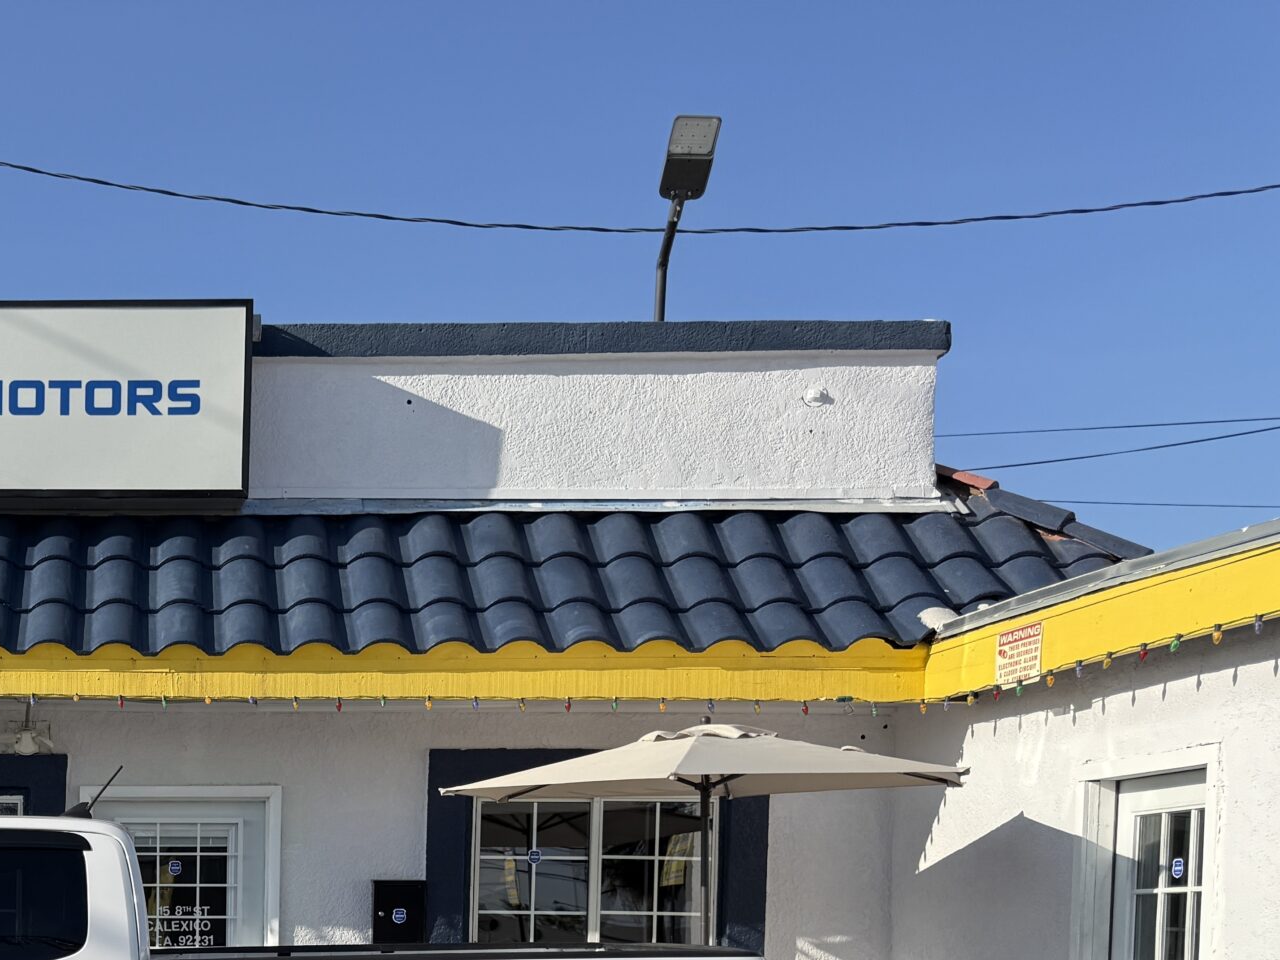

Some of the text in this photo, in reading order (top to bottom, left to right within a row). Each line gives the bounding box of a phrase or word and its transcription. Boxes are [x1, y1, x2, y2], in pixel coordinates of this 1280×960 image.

[1000, 625, 1041, 645] WARNING
[193, 906, 210, 918] ST
[148, 920, 211, 932] CALEXICO
